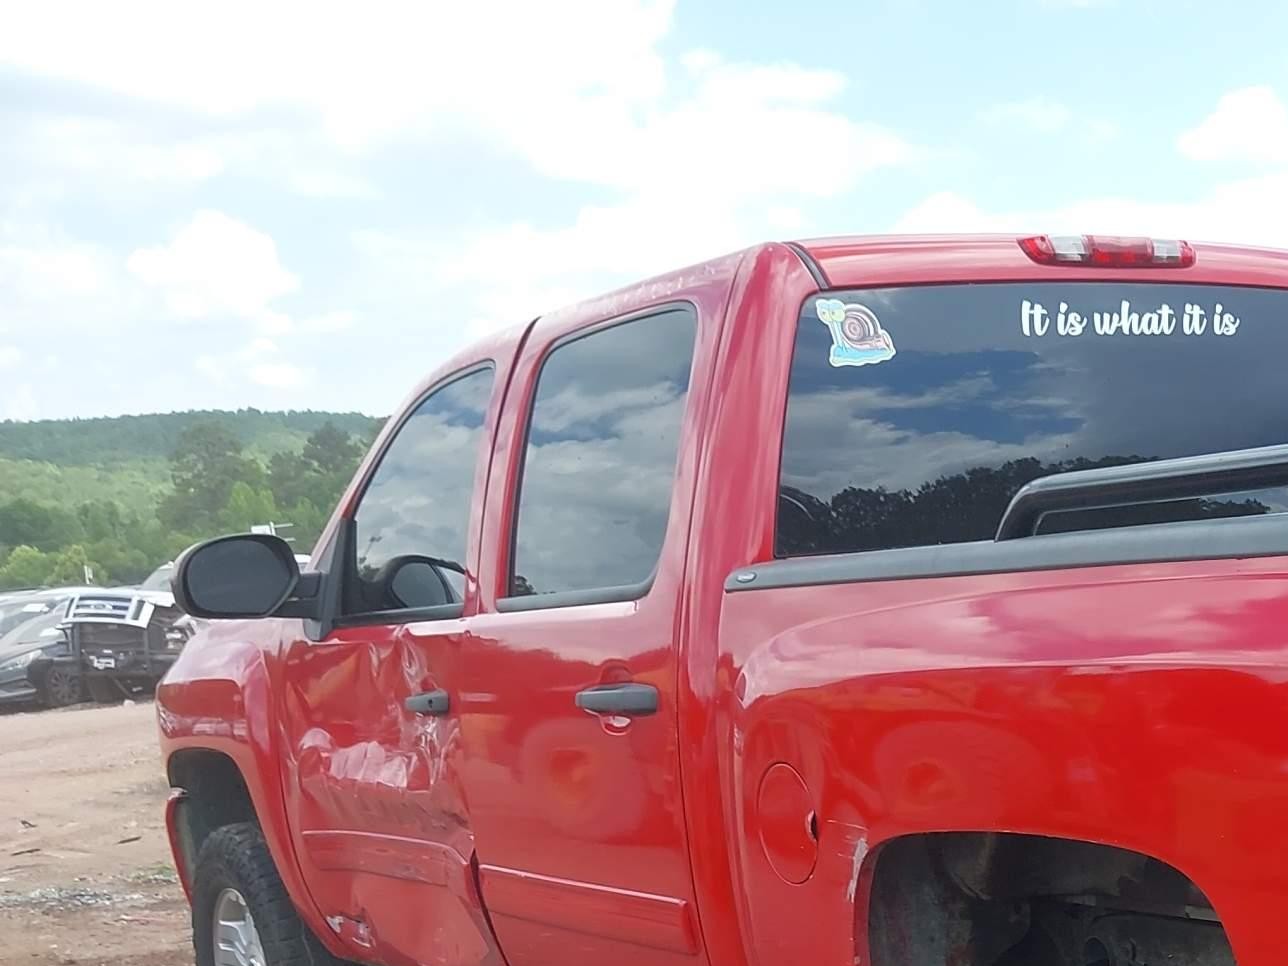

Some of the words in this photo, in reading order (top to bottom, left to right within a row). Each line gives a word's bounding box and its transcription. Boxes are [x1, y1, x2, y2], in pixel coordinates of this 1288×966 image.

[1021, 300, 1050, 336] It
[1056, 302, 1088, 336] is
[1093, 300, 1176, 335] what
[1182, 303, 1207, 335] it
[1213, 303, 1240, 336] is
